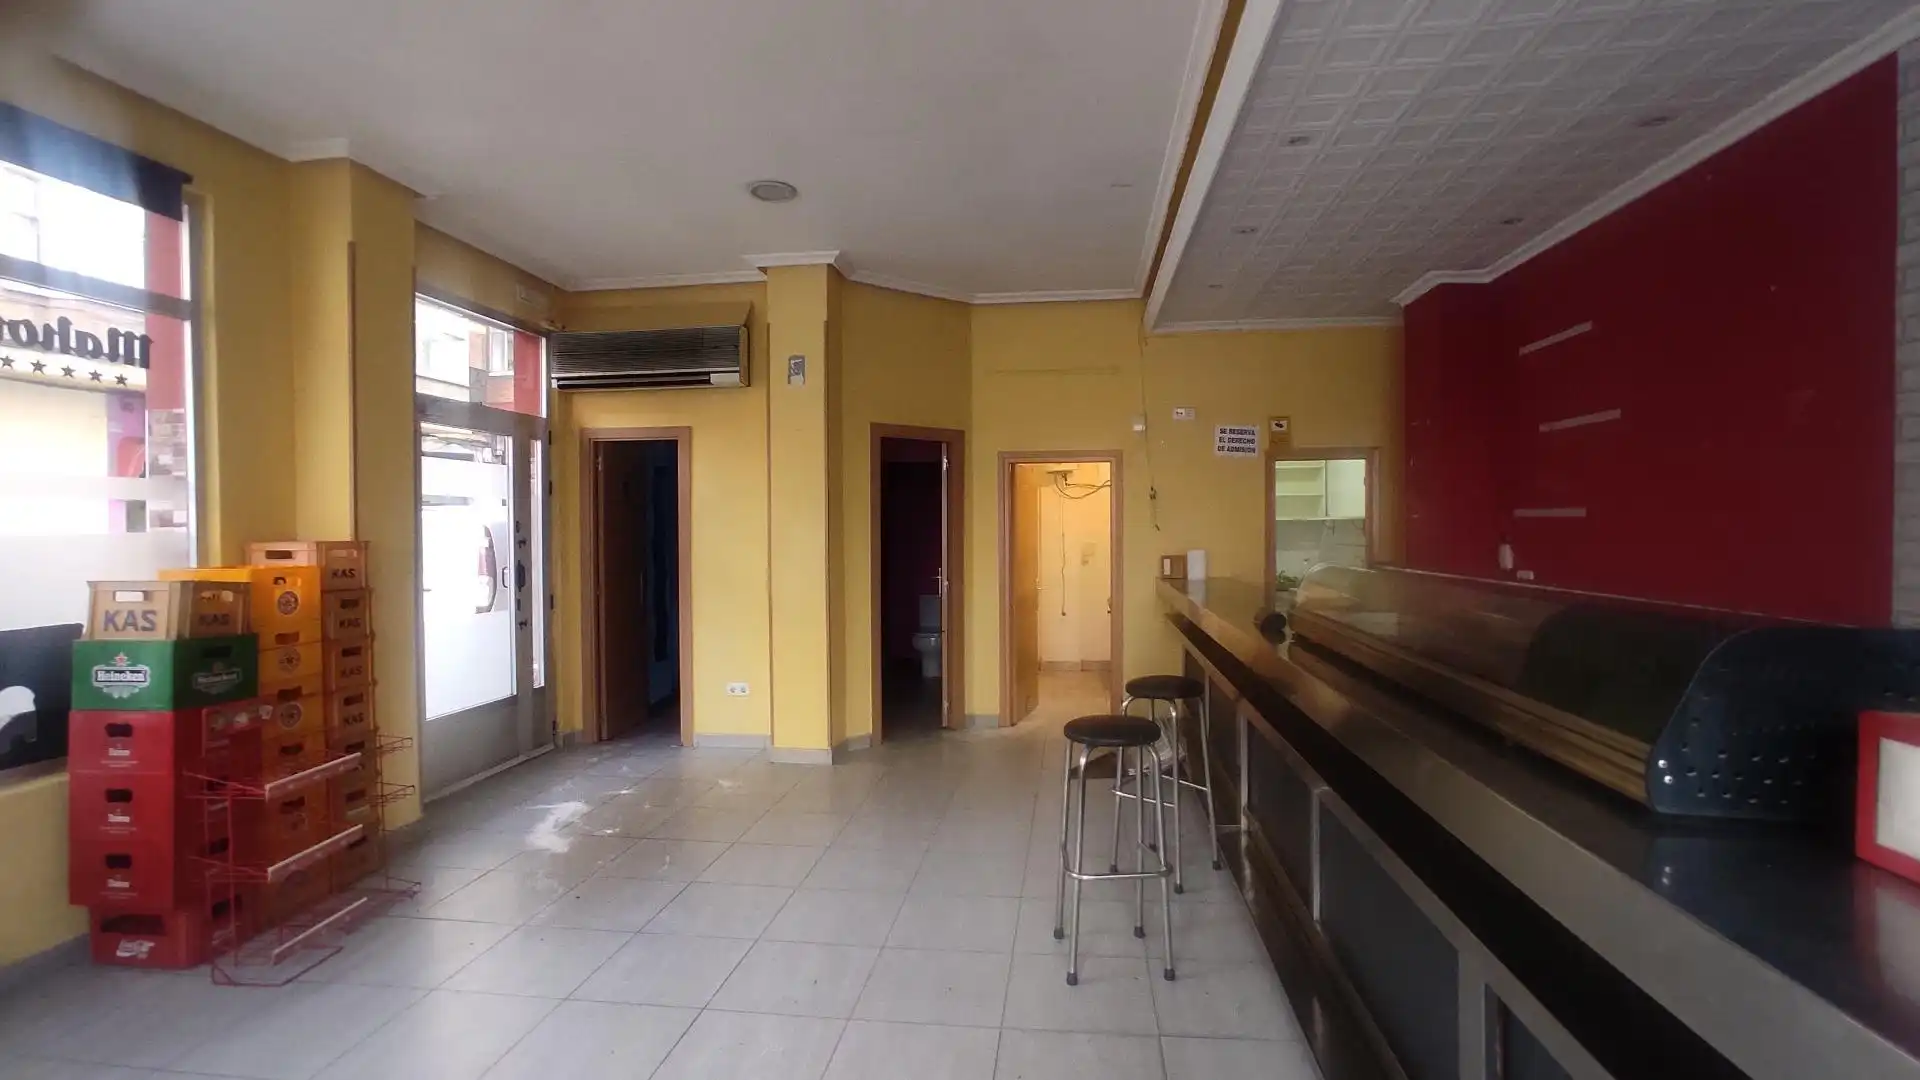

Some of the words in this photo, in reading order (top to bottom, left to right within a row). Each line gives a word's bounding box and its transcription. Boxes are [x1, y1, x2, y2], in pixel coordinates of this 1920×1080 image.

[330, 568, 357, 579] KAS
[103, 609, 157, 632] KAS
[96, 670, 146, 682] Heineken
